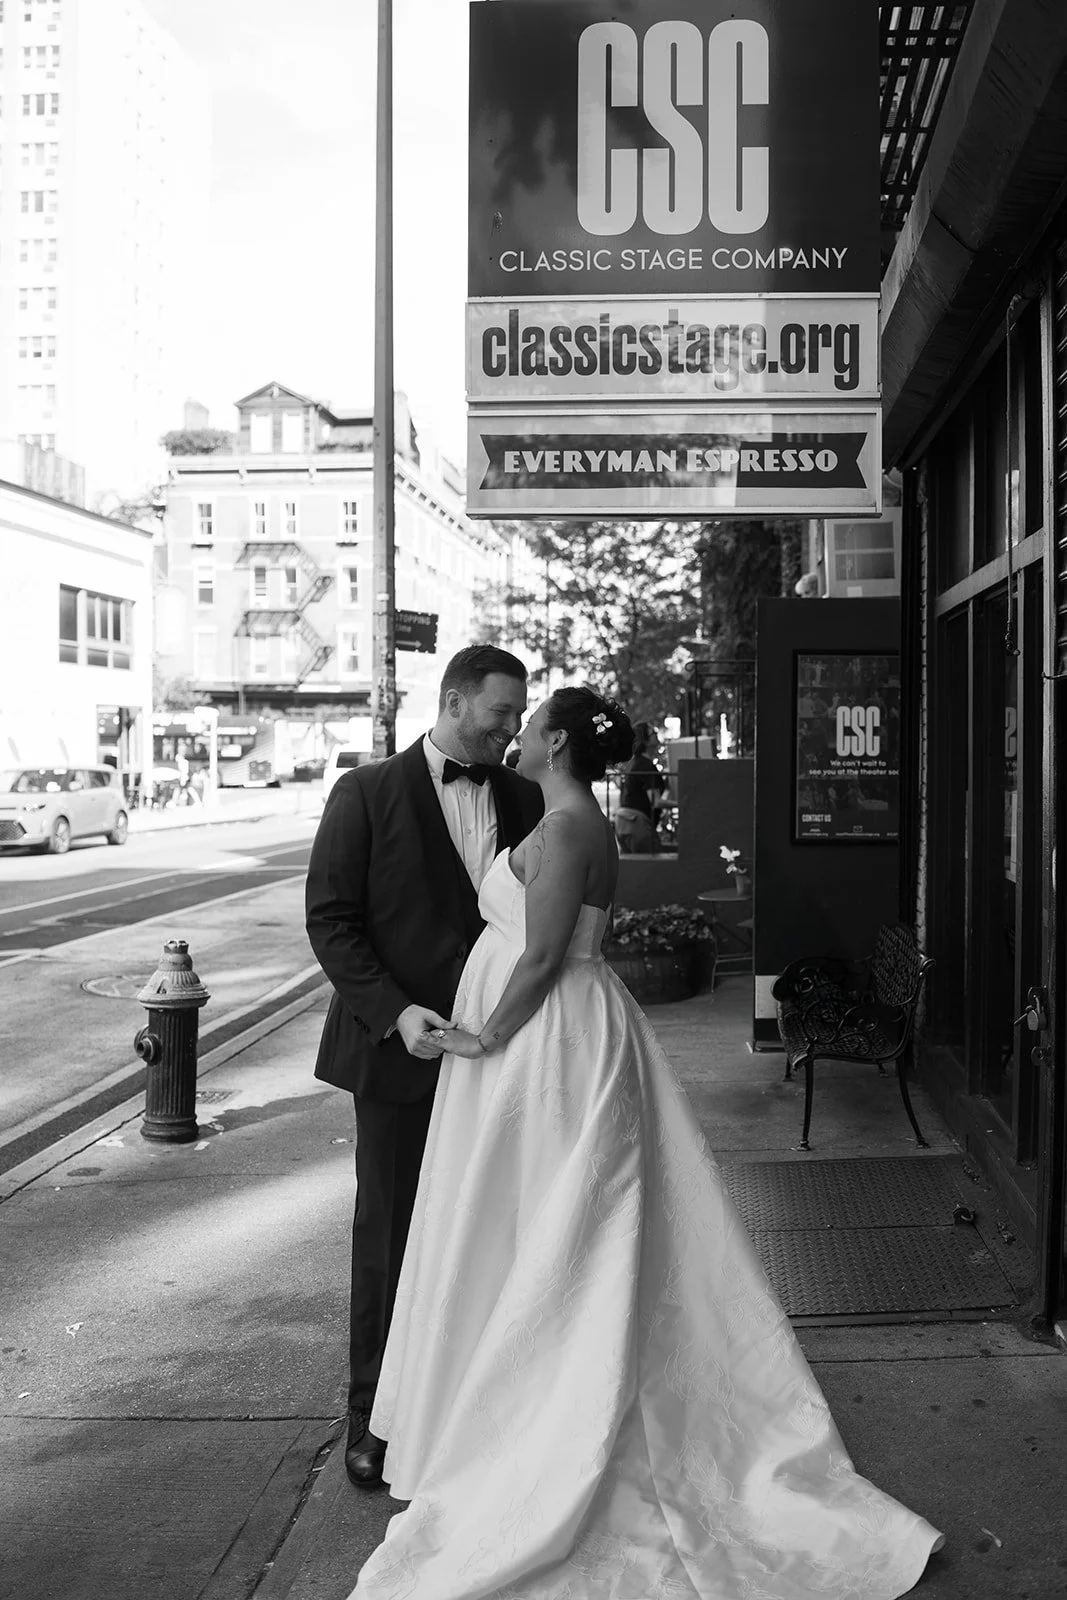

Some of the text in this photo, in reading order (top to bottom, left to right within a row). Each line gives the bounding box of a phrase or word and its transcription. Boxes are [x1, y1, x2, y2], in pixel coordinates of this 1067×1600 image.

[577, 19, 770, 236] CSC
[499, 247, 848, 273] CLASSIC STAGE COMPANY
[482, 308, 861, 391] classicstage.org
[504, 449, 839, 473] EVERYMAN ESPRESSO
[836, 706, 880, 756] CSC
[802, 814, 831, 822] CONTACT US
